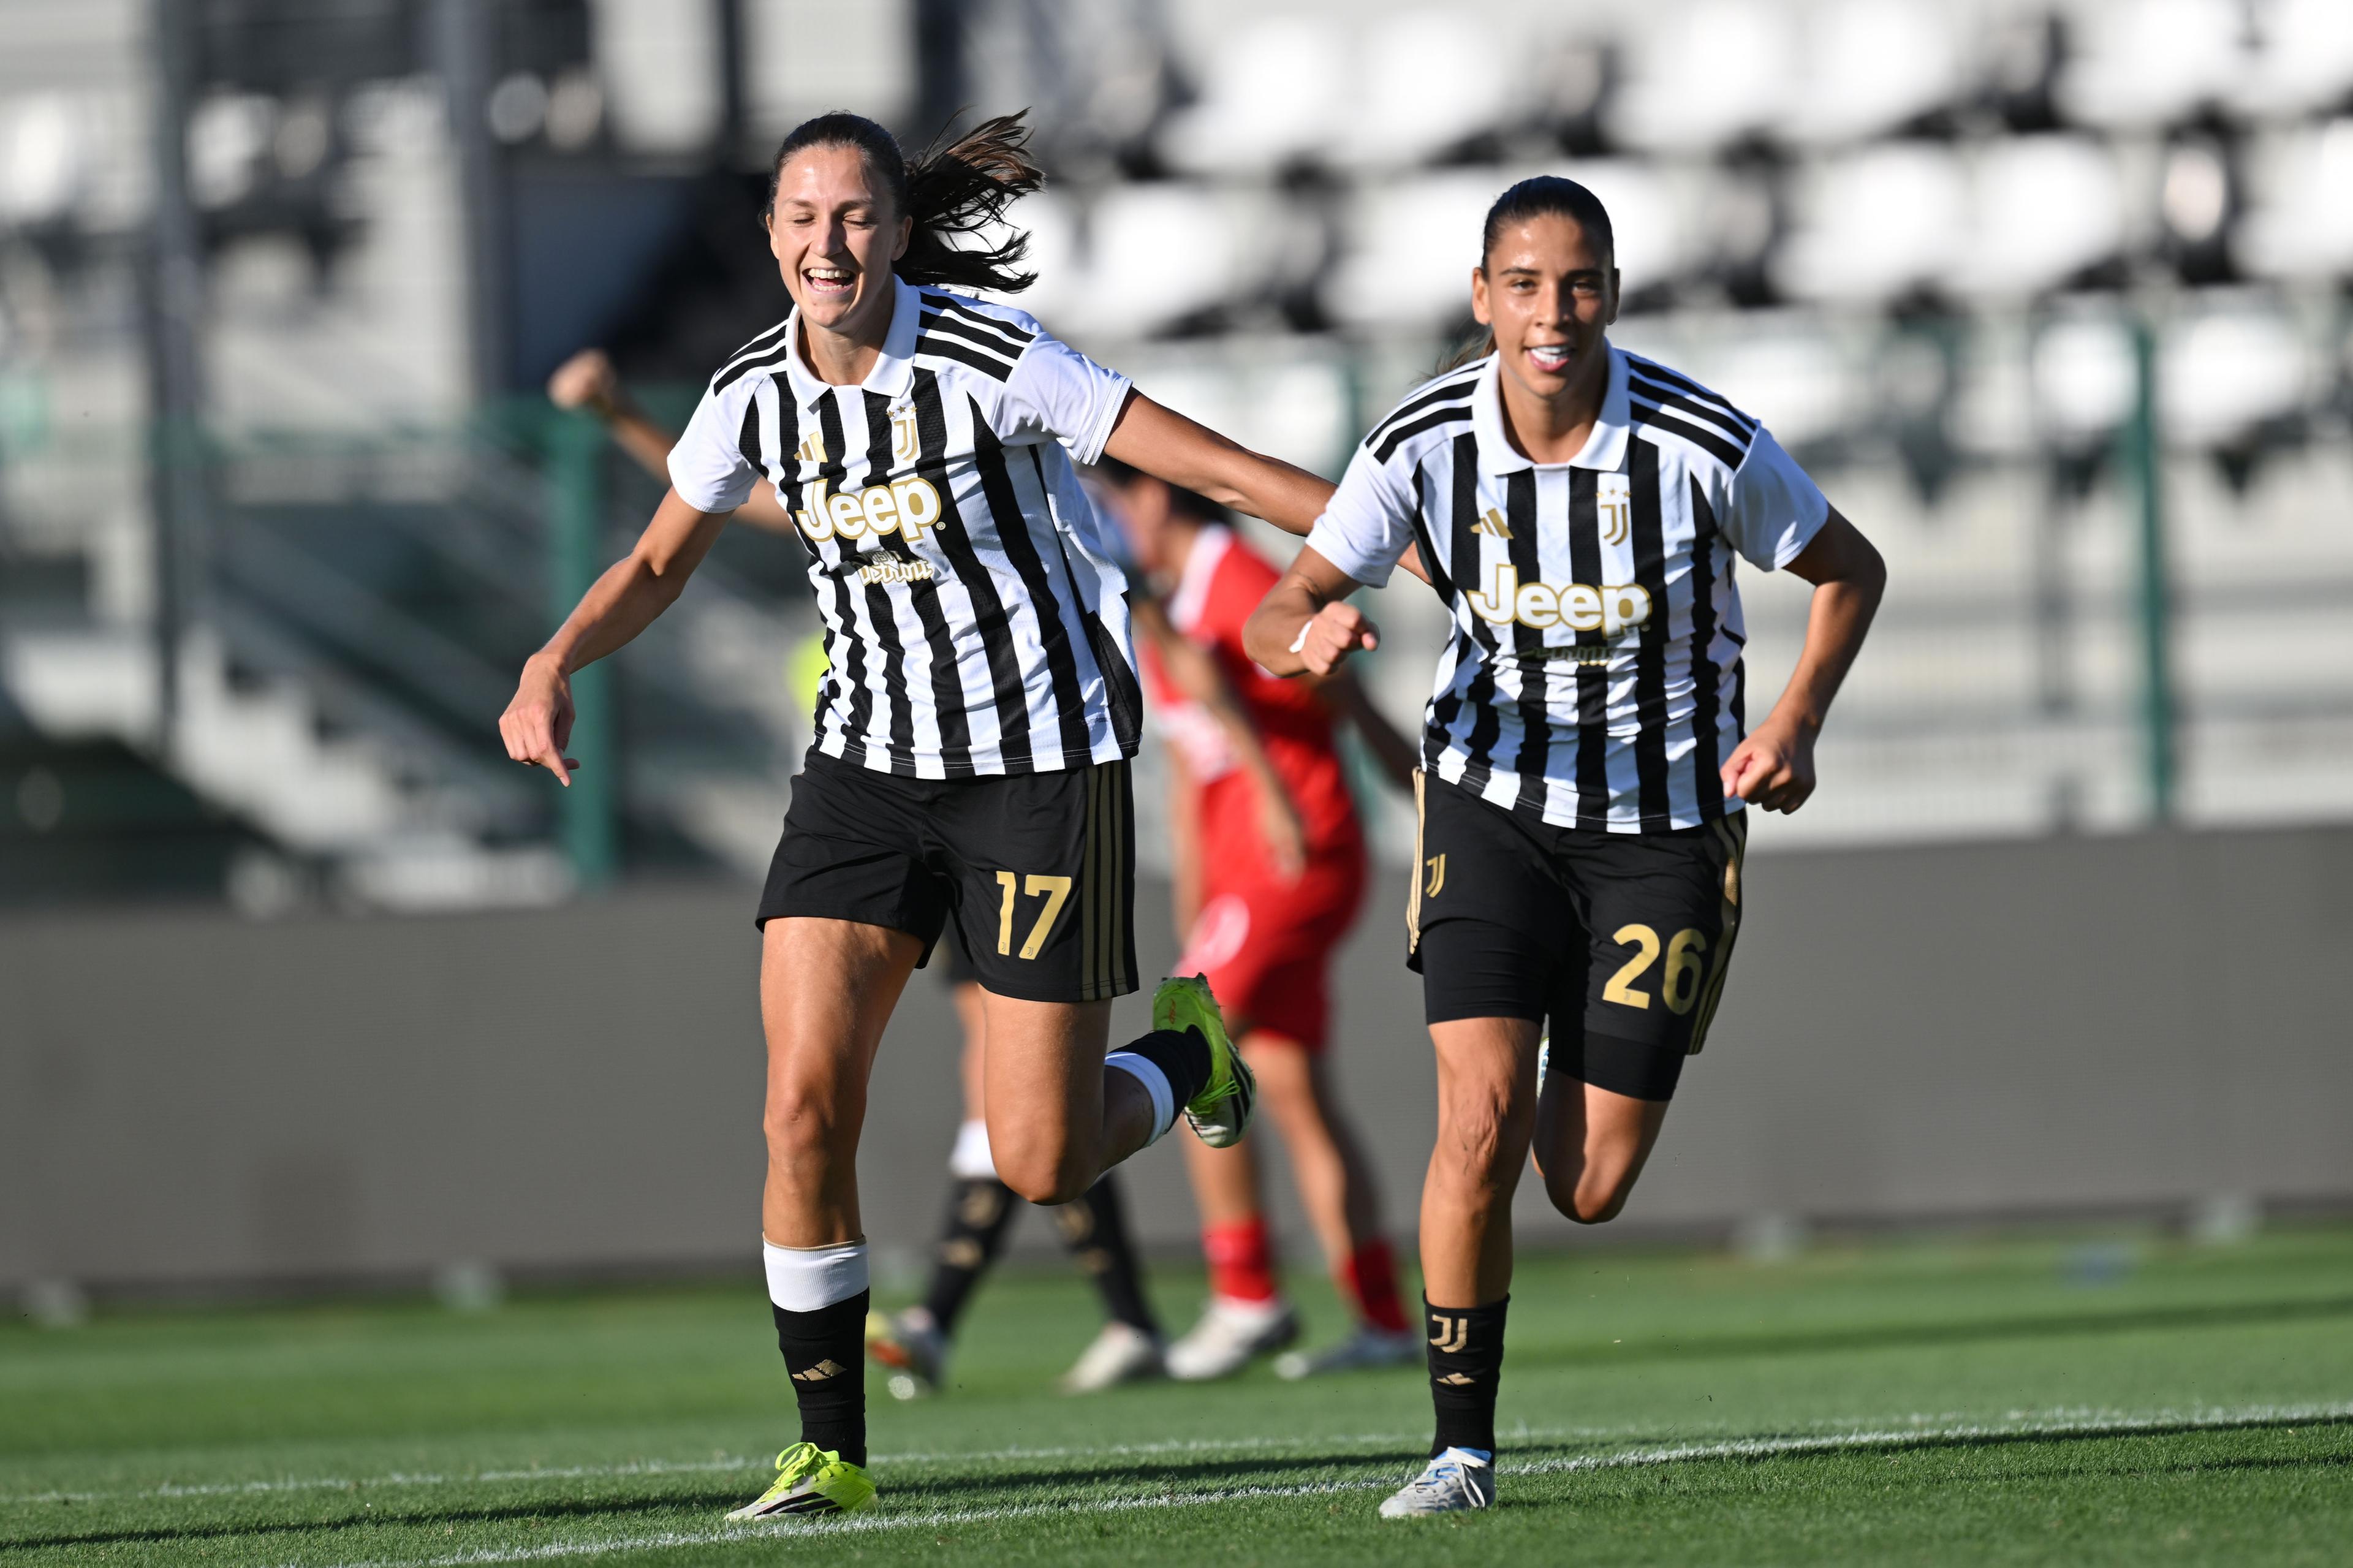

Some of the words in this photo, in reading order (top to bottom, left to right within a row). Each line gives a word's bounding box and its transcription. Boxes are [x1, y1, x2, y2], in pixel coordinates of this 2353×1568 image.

[795, 478, 941, 543] Jeep
[1466, 563, 1653, 640] Jeep
[996, 871, 1072, 960] 17
[1602, 923, 1707, 1015] 26
